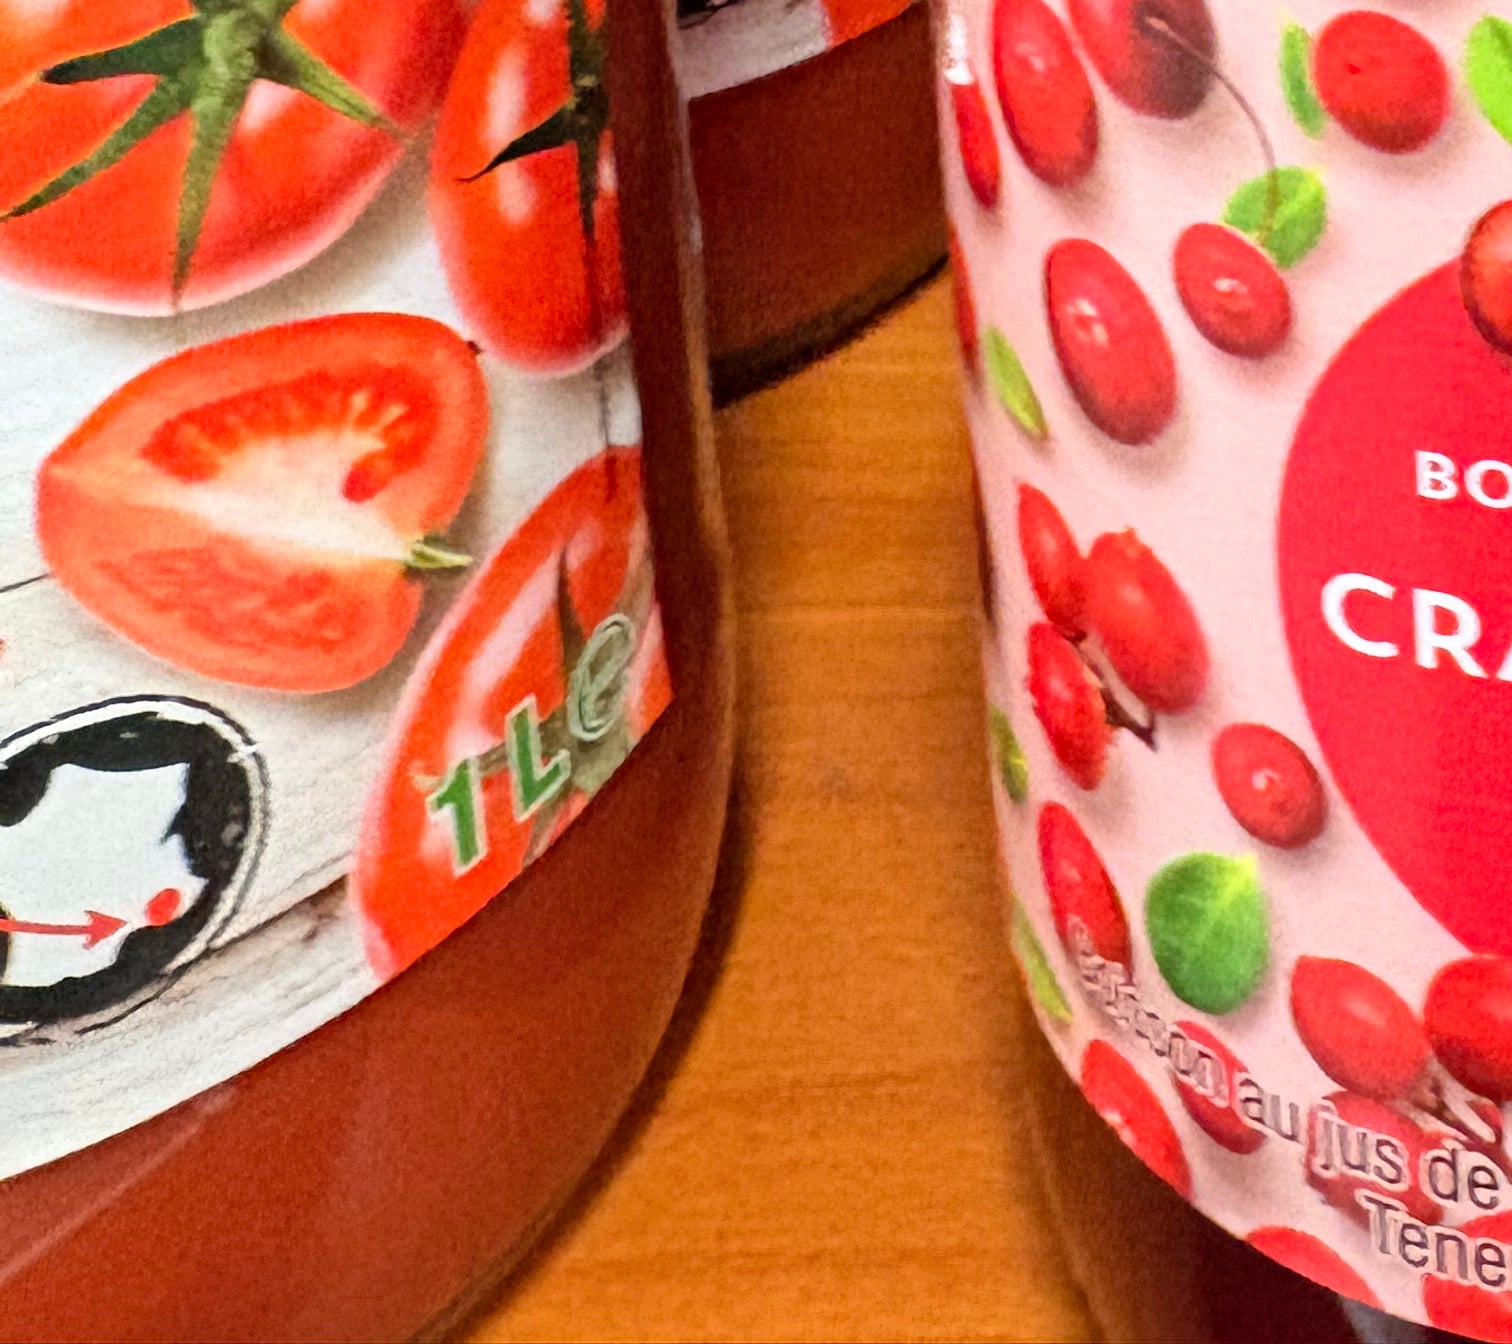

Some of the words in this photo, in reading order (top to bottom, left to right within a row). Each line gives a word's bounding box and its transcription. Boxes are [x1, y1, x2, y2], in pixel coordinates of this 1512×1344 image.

[430, 755, 484, 867] 1
[1238, 1078, 1301, 1142] au
[1316, 1104, 1404, 1185] jus
[1427, 1148, 1500, 1210] de
